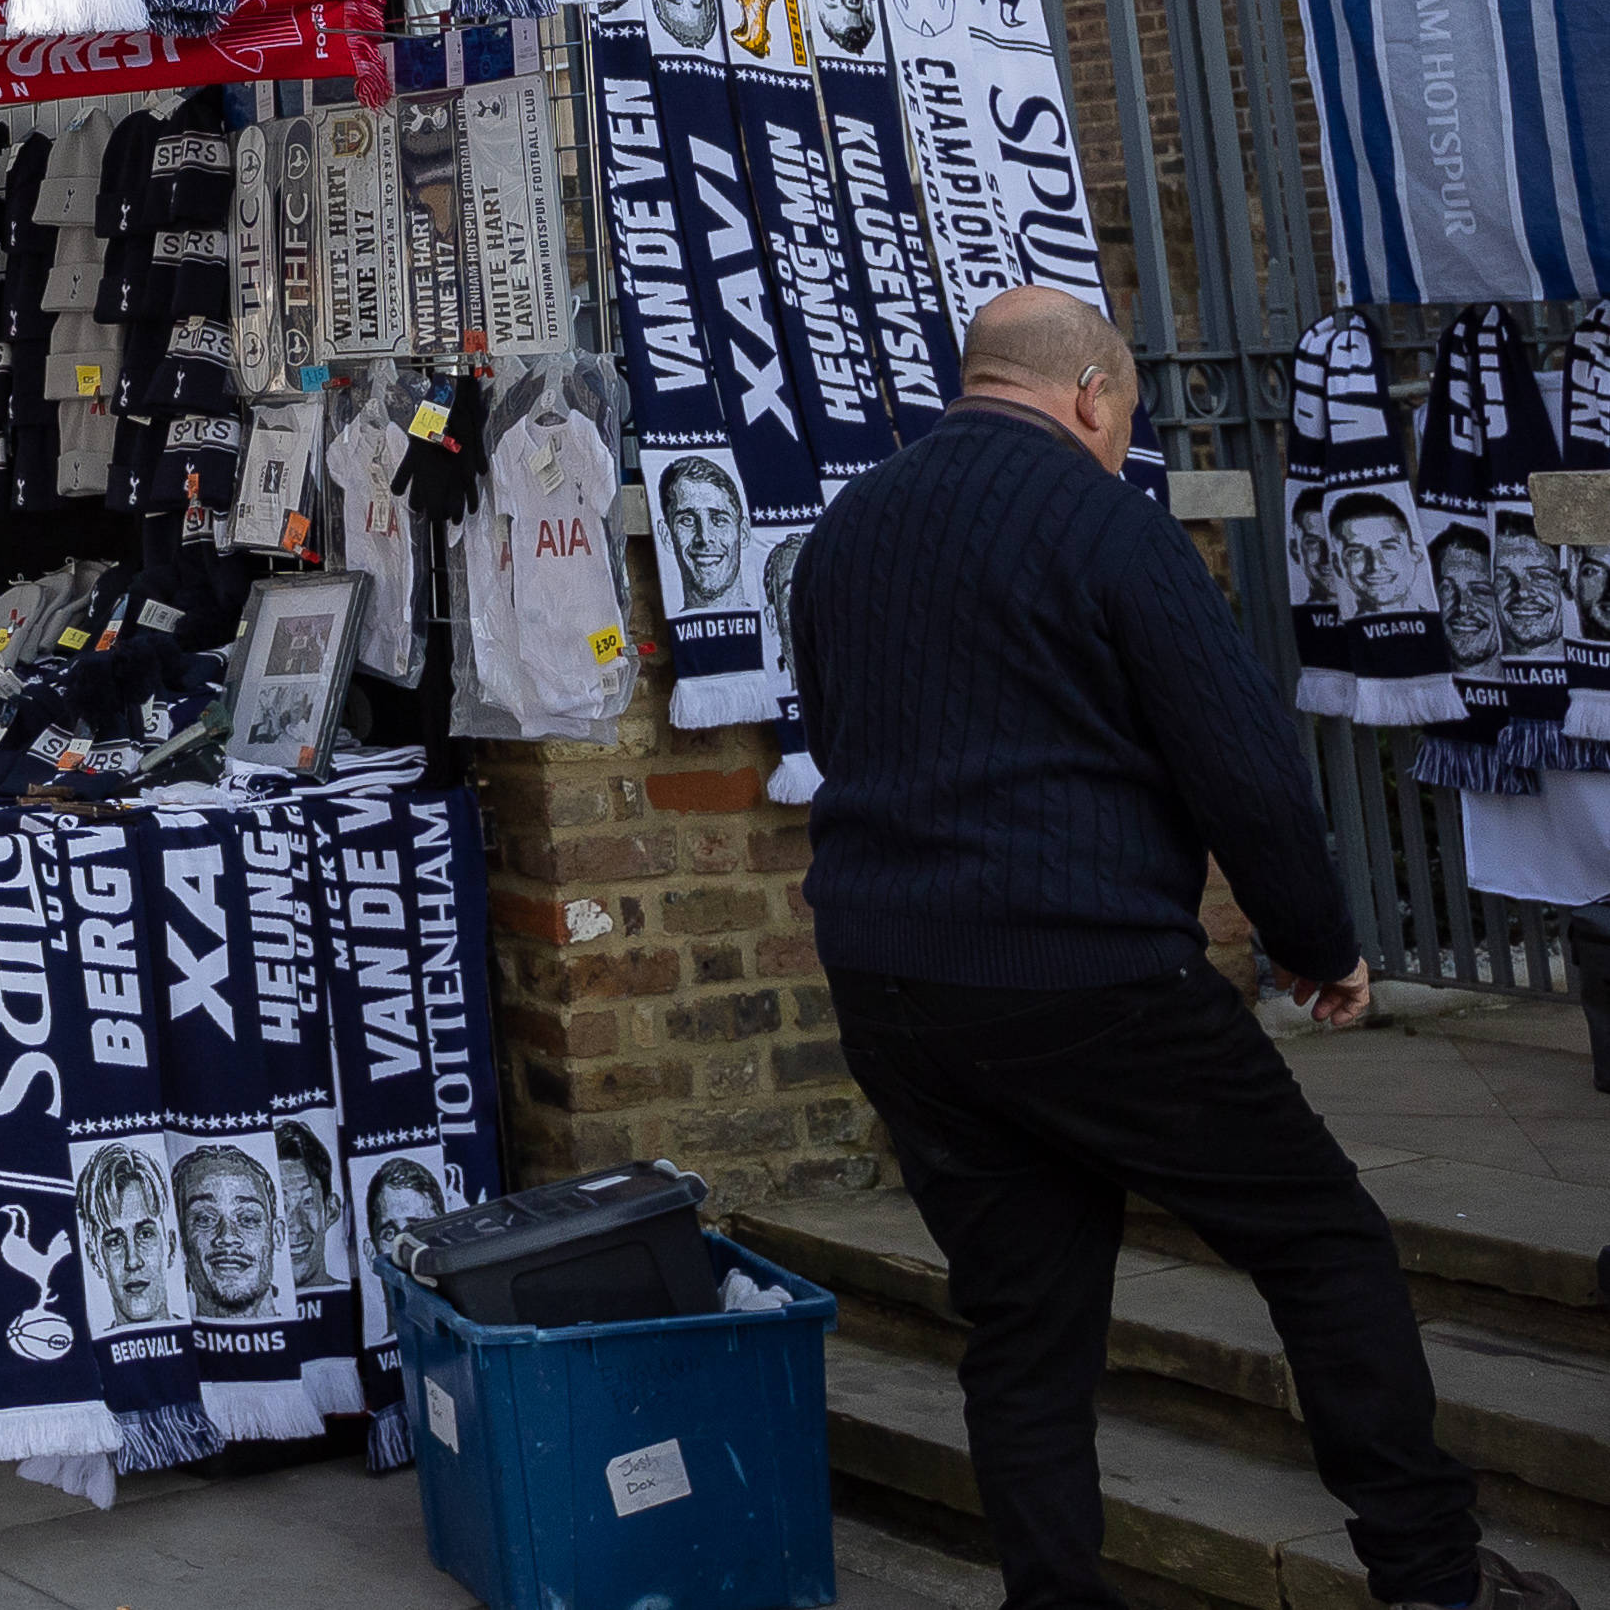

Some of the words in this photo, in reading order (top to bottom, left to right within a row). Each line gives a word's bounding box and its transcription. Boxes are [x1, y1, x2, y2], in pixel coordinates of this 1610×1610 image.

[523, 88, 535, 124] CLUB
[603, 77, 667, 186] VEN
[1421, 50, 1478, 238] HOTSPUR
[381, 123, 396, 208] HOTSPUR
[530, 125, 546, 195] FOOTBALL
[915, 56, 1009, 290] CHAMPIONS
[917, 128, 955, 246] KNOW
[987, 84, 1103, 290] SPU
[327, 164, 350, 239] HART
[354, 210, 376, 257] N17
[480, 183, 506, 251] HART
[506, 220, 526, 264] N17
[538, 195, 550, 261] HOTSPUR
[622, 200, 684, 270] DE
[806, 147, 851, 292] LEGEND
[240, 195, 262, 319] THFC
[285, 192, 309, 316] THFC
[382, 216, 400, 332] TOTTENHAM
[411, 210, 432, 275] HART
[436, 240, 457, 286] N17
[764, 119, 867, 424] HEUNG-MIN
[769, 231, 800, 310] SON
[833, 114, 946, 412] KULUSEVSKI
[899, 211, 941, 313] DEJAN
[329, 248, 354, 341] WHITE
[356, 267, 379, 341] LANE
[414, 277, 437, 347] WHITE
[438, 287, 460, 344] LANE
[488, 258, 514, 344] WHITE
[510, 276, 535, 341] LANE
[540, 262, 559, 341] TOTTENHAM
[688, 134, 800, 442] XAVI
[637, 280, 708, 392] VAN
[840, 303, 879, 400] CLUB
[535, 516, 593, 559] AIA
[593, 633, 618, 657] £30
[677, 619, 703, 642] VAN
[705, 618, 729, 639] DE
[729, 616, 757, 637] VEN
[1361, 619, 1427, 641] VICARIO
[1505, 667, 1568, 686] ALLAGH
[314, 818, 351, 972] MICKY
[341, 847, 407, 931] DE
[295, 898, 318, 1014] CLUB
[409, 799, 478, 1147] TOTTENHAM
[354, 945, 423, 1083] VAN
[110, 1333, 184, 1365] BERGVALL
[192, 1329, 287, 1354] SIMONS
